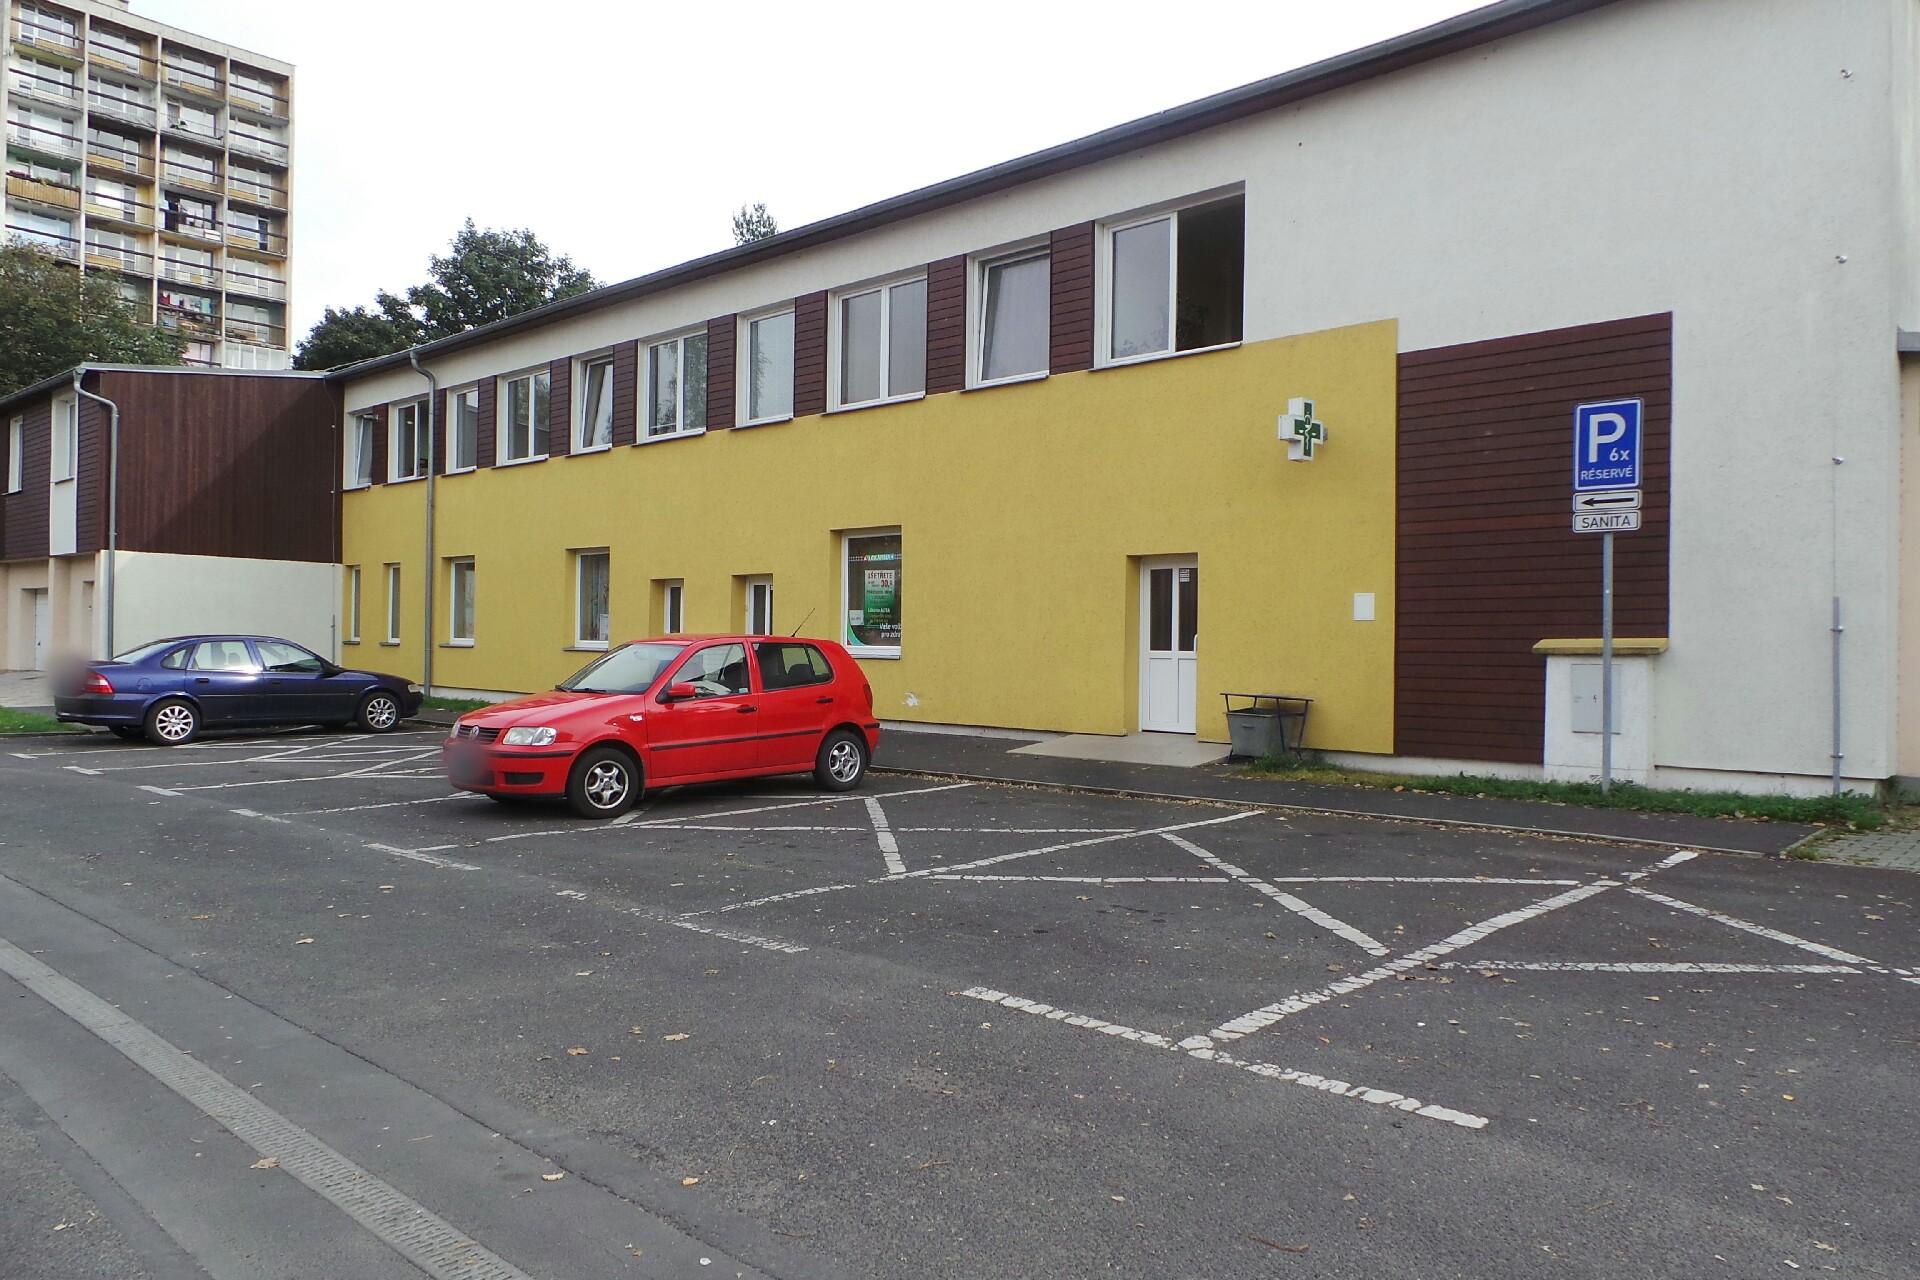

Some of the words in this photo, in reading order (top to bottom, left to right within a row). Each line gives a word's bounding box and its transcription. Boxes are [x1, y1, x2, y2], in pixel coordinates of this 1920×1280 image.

[1588, 413, 1626, 463] P
[1610, 447, 1631, 462] 6x
[1580, 465, 1633, 480] RÉSERVÉ
[1581, 515, 1631, 529] SANITA
